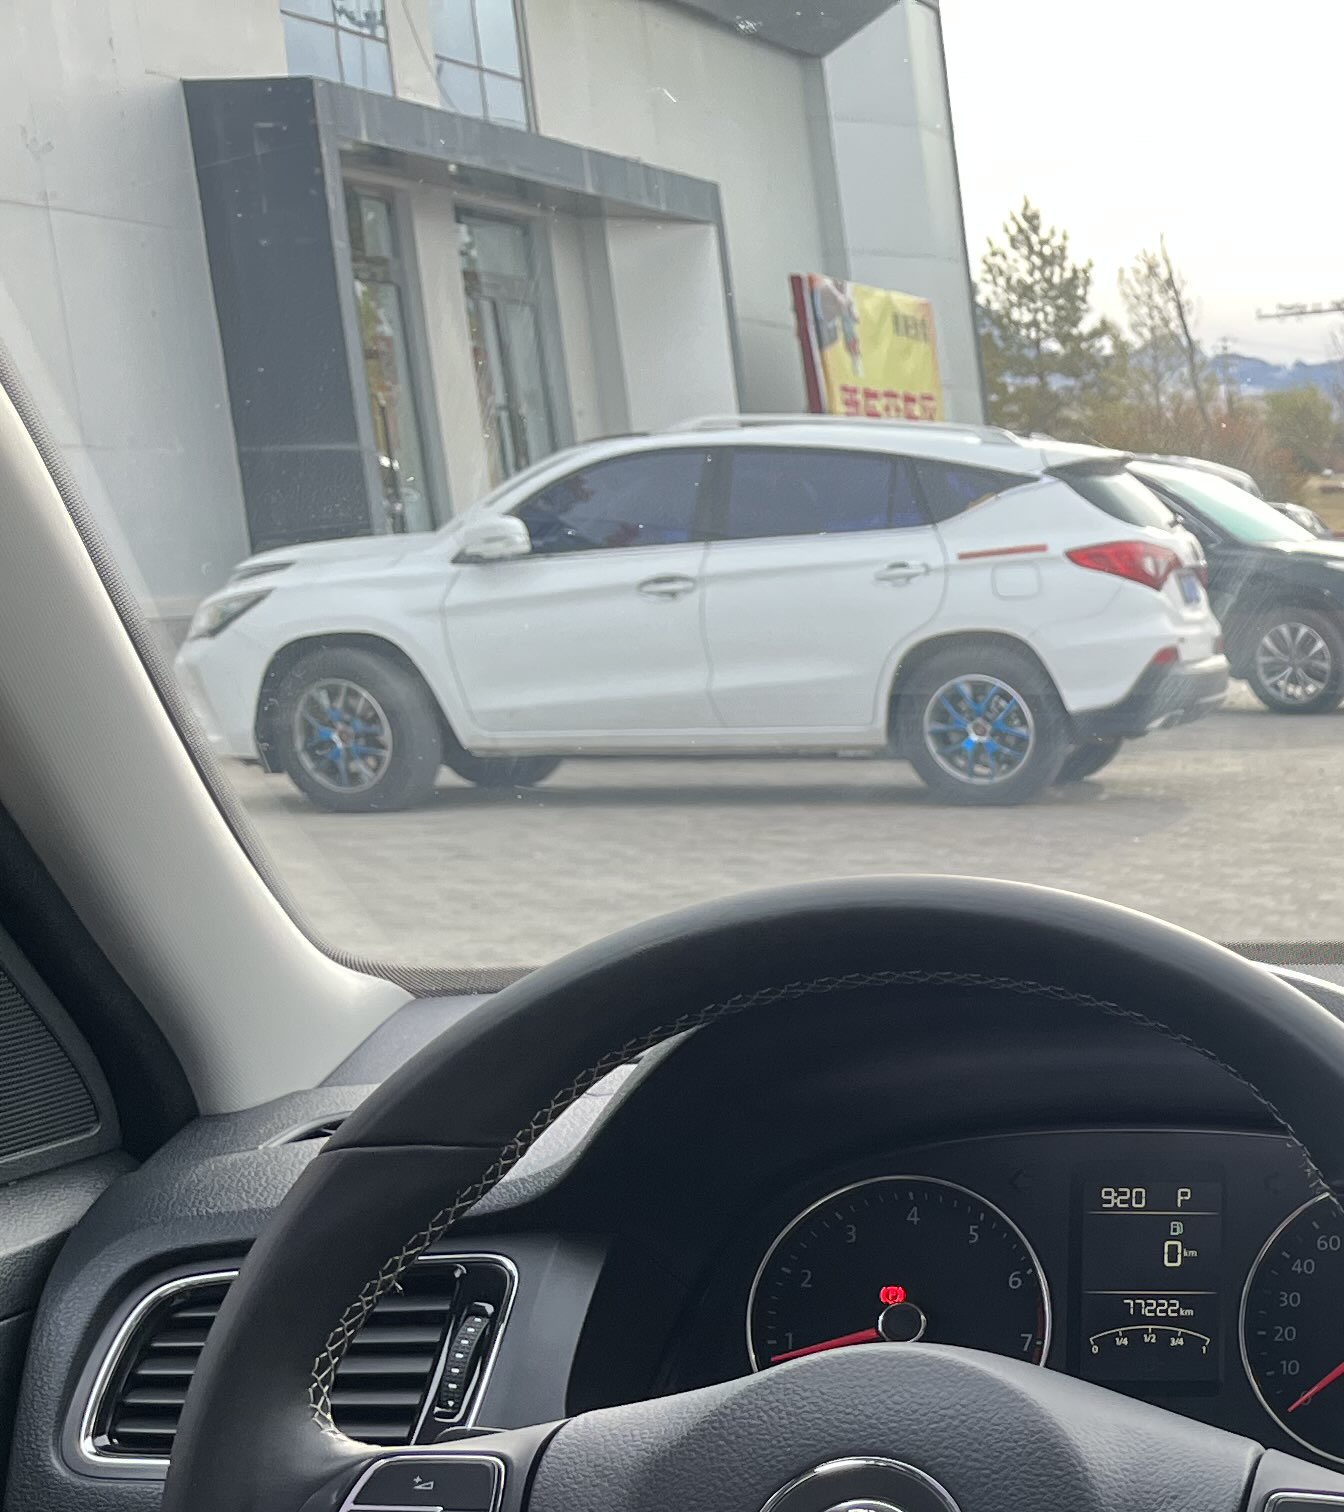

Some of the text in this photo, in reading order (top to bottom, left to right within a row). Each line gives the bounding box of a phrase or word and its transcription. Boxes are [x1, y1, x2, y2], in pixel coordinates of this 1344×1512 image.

[1101, 1188, 1146, 1208] 9:20
[1177, 1188, 1191, 1208] P
[906, 1206, 920, 1225] 4
[846, 1225, 857, 1243] 3
[968, 1225, 980, 1243] 5
[1316, 1235, 1341, 1251] 60
[1291, 1259, 1315, 1275] 40
[800, 1270, 812, 1288] 2
[1008, 1271, 1022, 1289] 6
[1279, 1291, 1301, 1307] 30
[1020, 1333, 1032, 1351] 7
[1273, 1326, 1296, 1342] 20
[1280, 1360, 1300, 1375] 10
